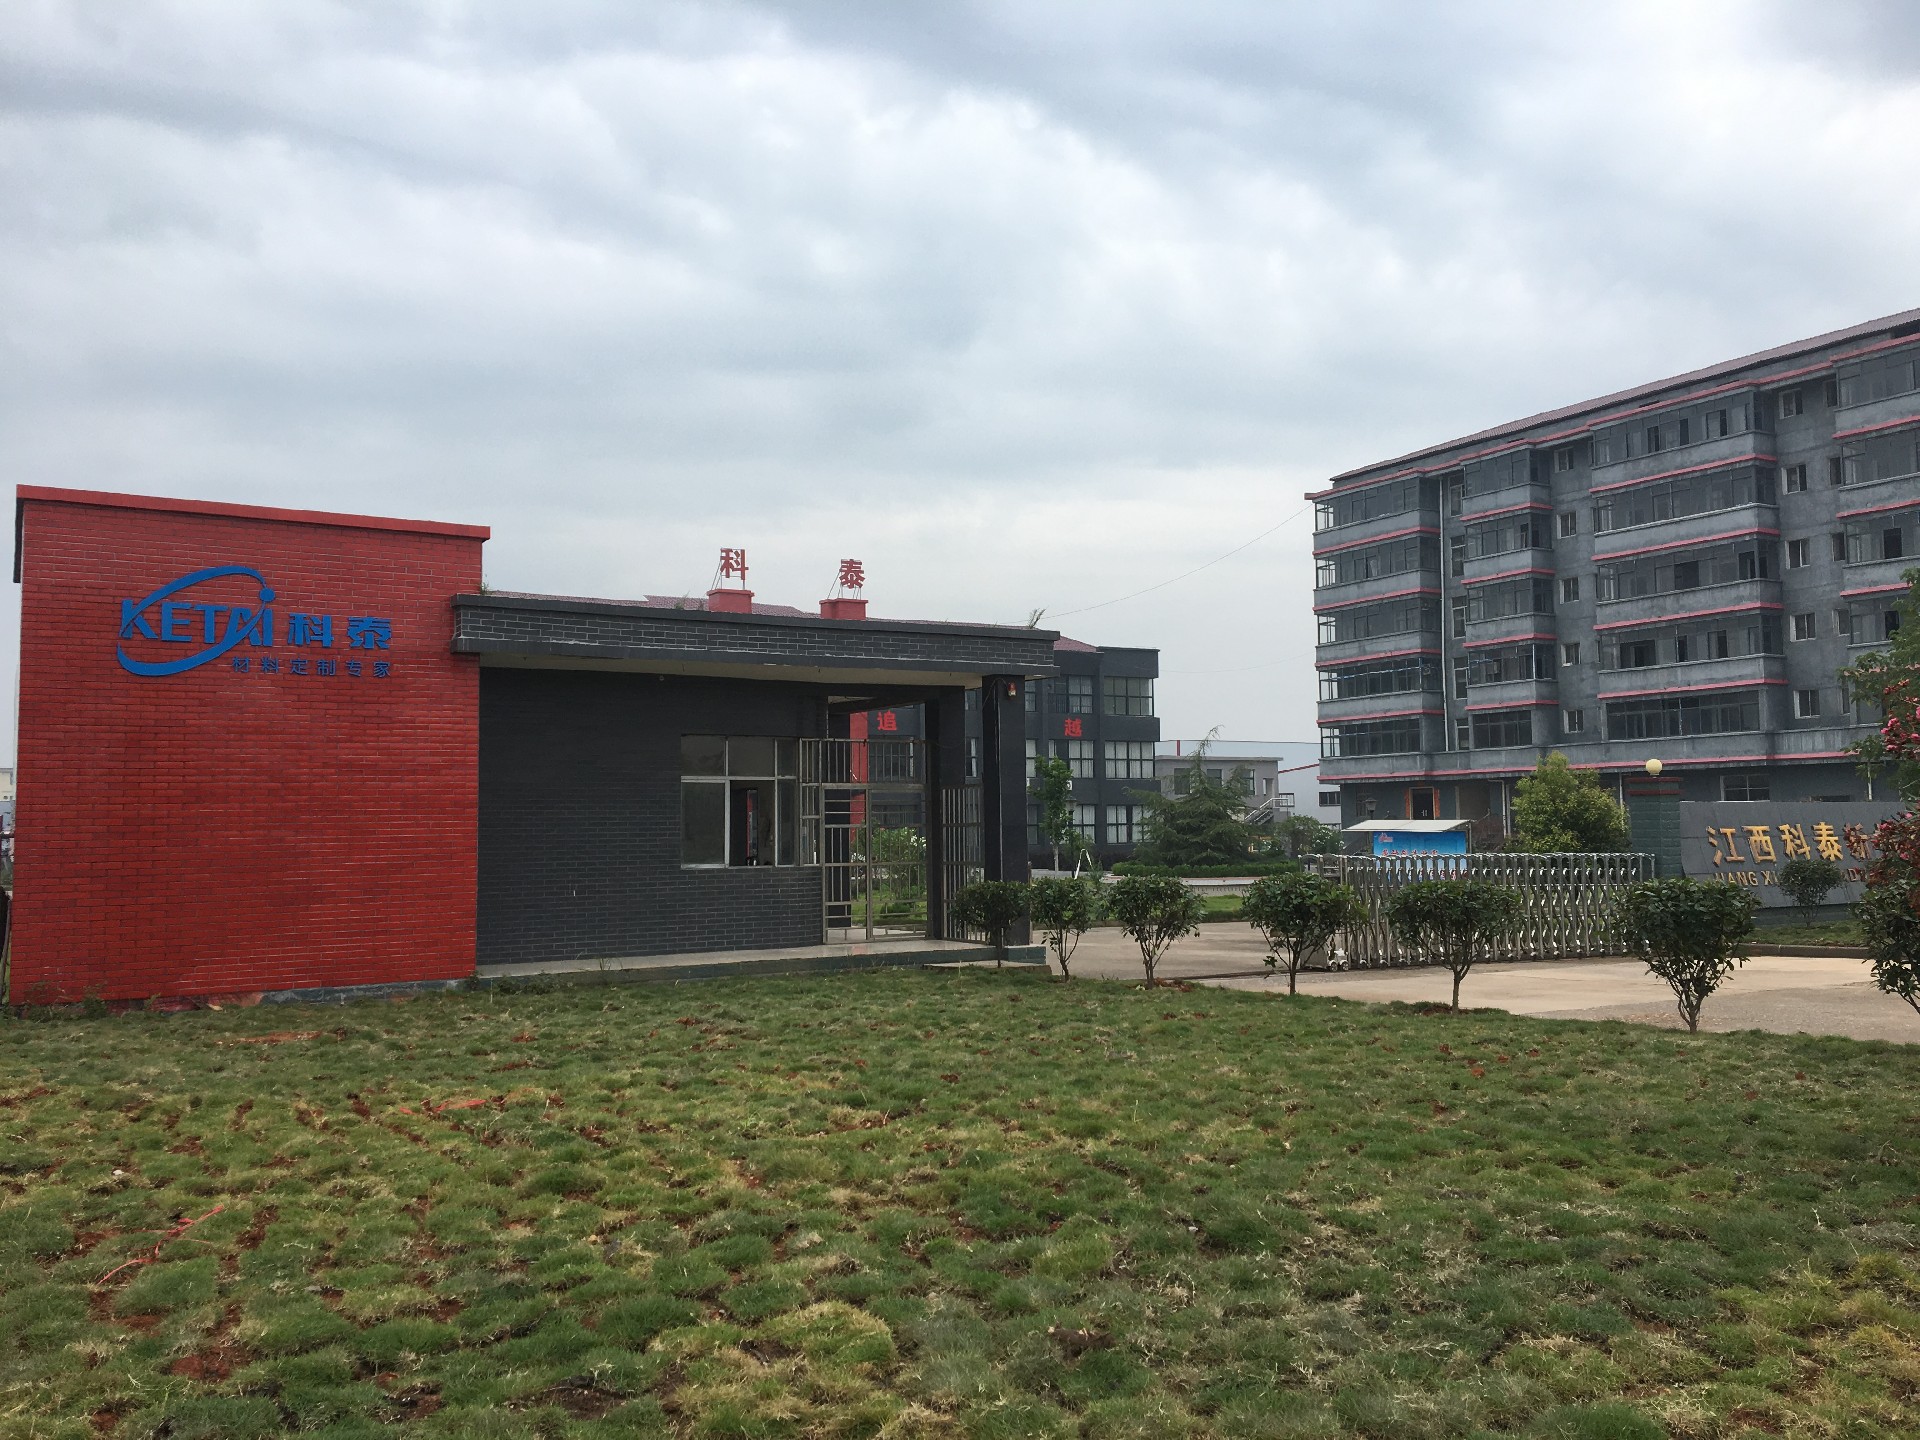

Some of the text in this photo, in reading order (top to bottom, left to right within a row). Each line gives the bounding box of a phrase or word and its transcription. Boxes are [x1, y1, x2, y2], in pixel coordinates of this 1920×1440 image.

[720, 548, 866, 589] 科 泰
[287, 612, 392, 649] 科泰
[232, 656, 391, 678] 材料定制专家
[877, 710, 897, 731] 追
[1064, 718, 1083, 737] 越
